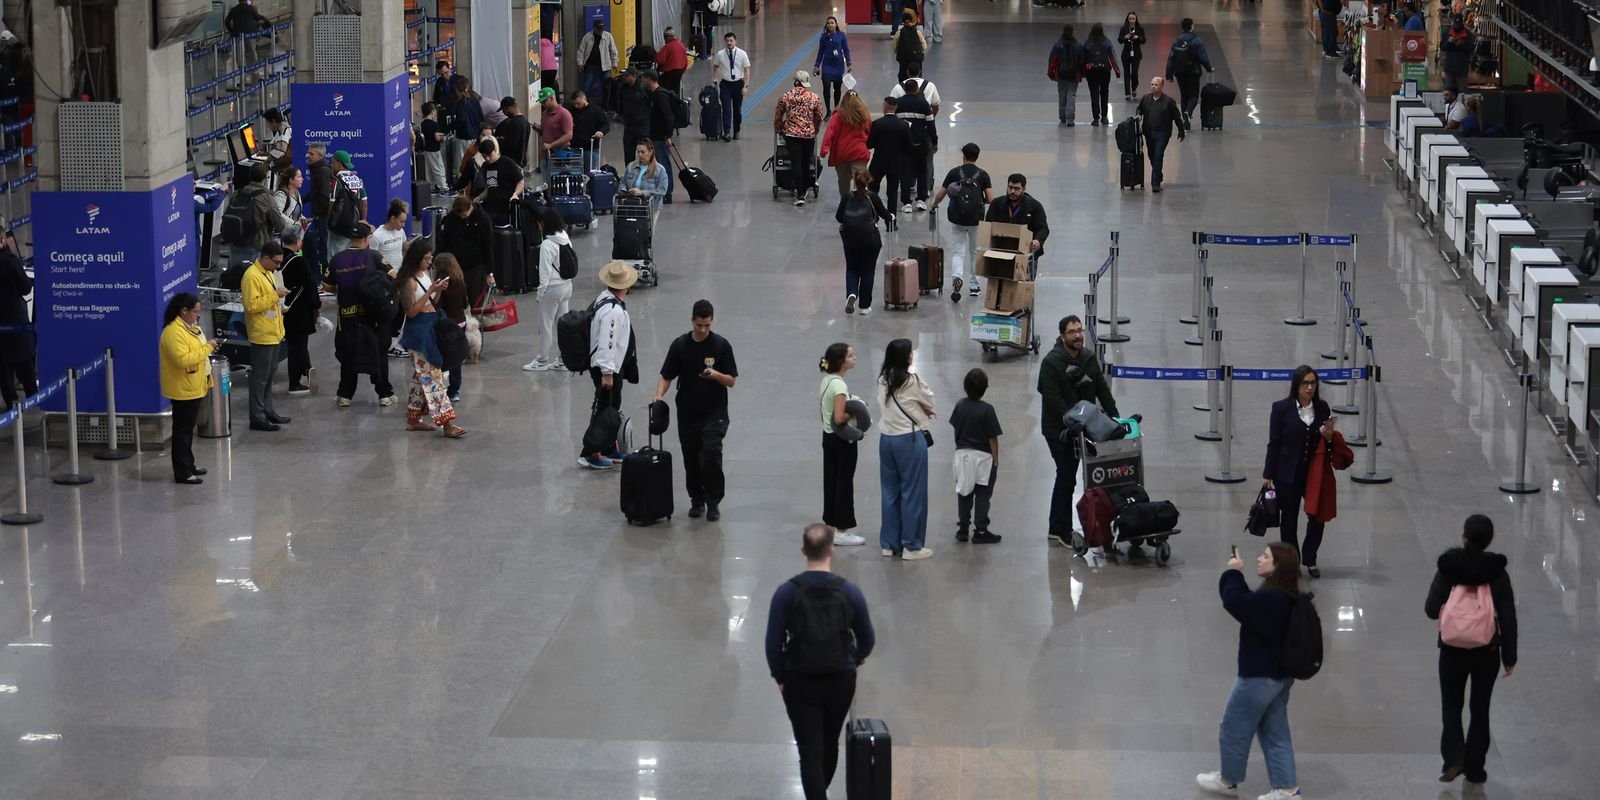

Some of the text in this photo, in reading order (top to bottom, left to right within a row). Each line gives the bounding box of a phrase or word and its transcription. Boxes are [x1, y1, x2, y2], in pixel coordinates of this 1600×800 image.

[304, 129, 362, 140] Começa aqui!
[50, 251, 124, 265] Começa aqui!
[51, 265, 85, 273] Start here!
[53, 304, 78, 312] Etiquete
[91, 304, 119, 313] Bagagem
